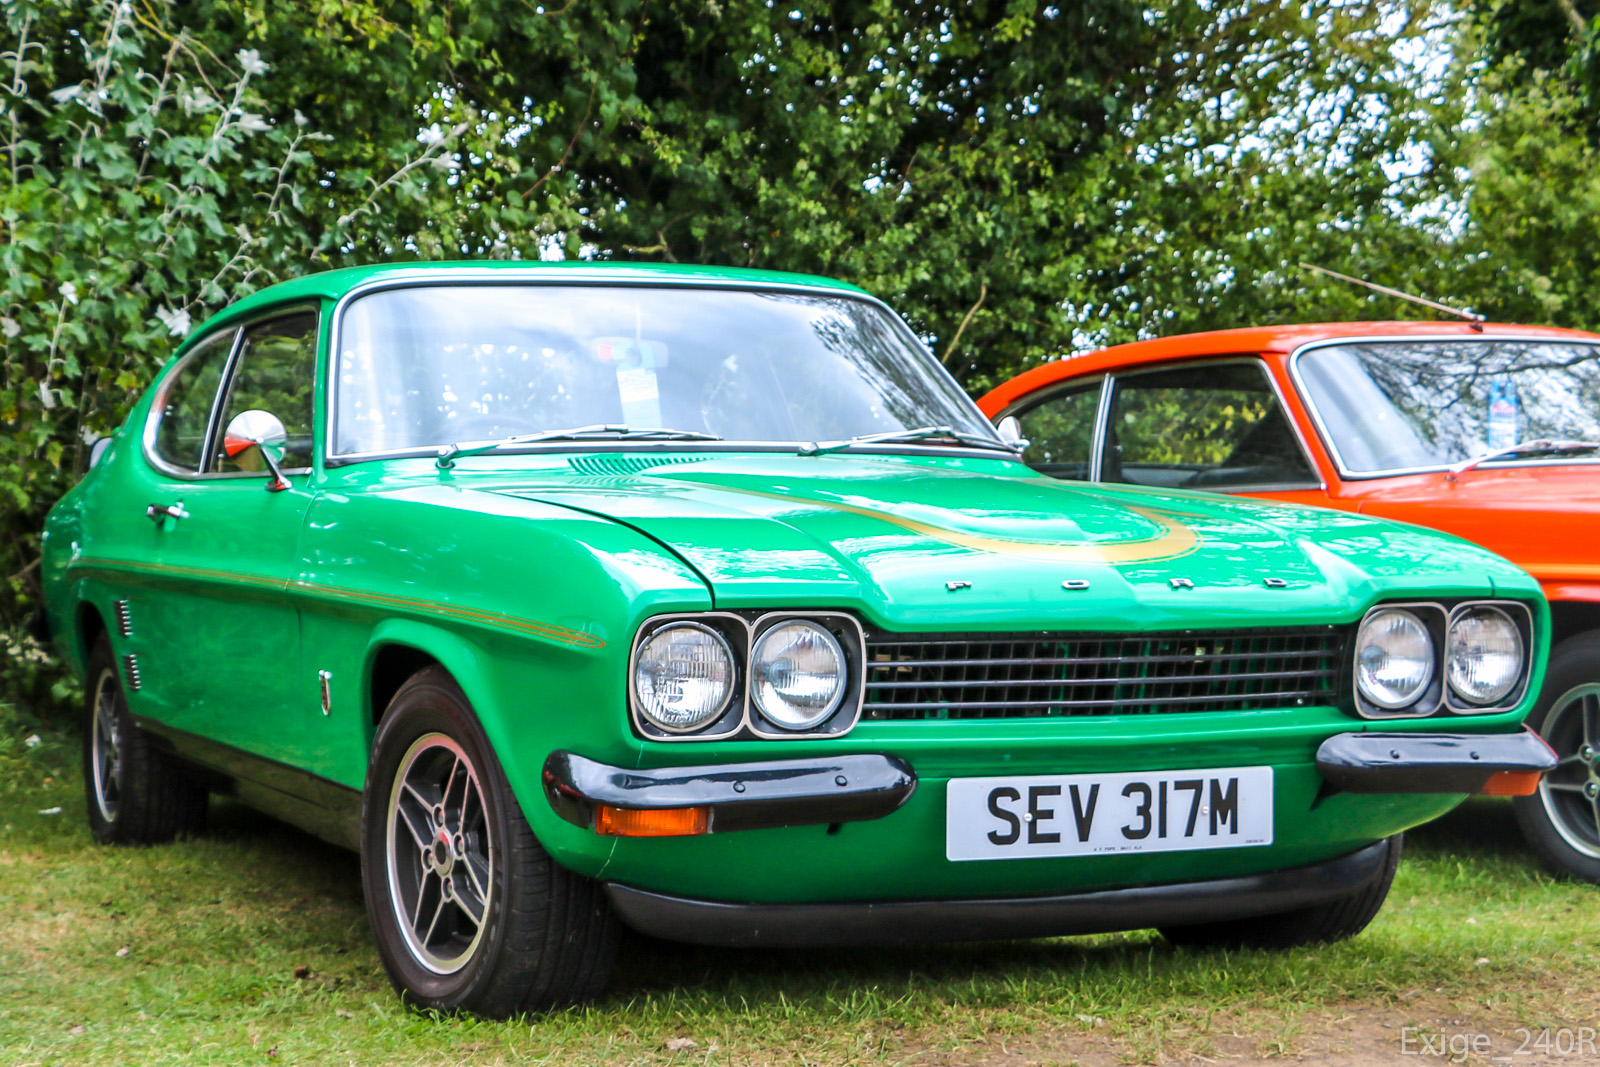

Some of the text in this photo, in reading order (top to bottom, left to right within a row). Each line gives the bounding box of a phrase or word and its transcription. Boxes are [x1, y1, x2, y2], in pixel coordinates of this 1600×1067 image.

[945, 577, 1288, 592] FORD
[987, 777, 1238, 845] SEV 317M
